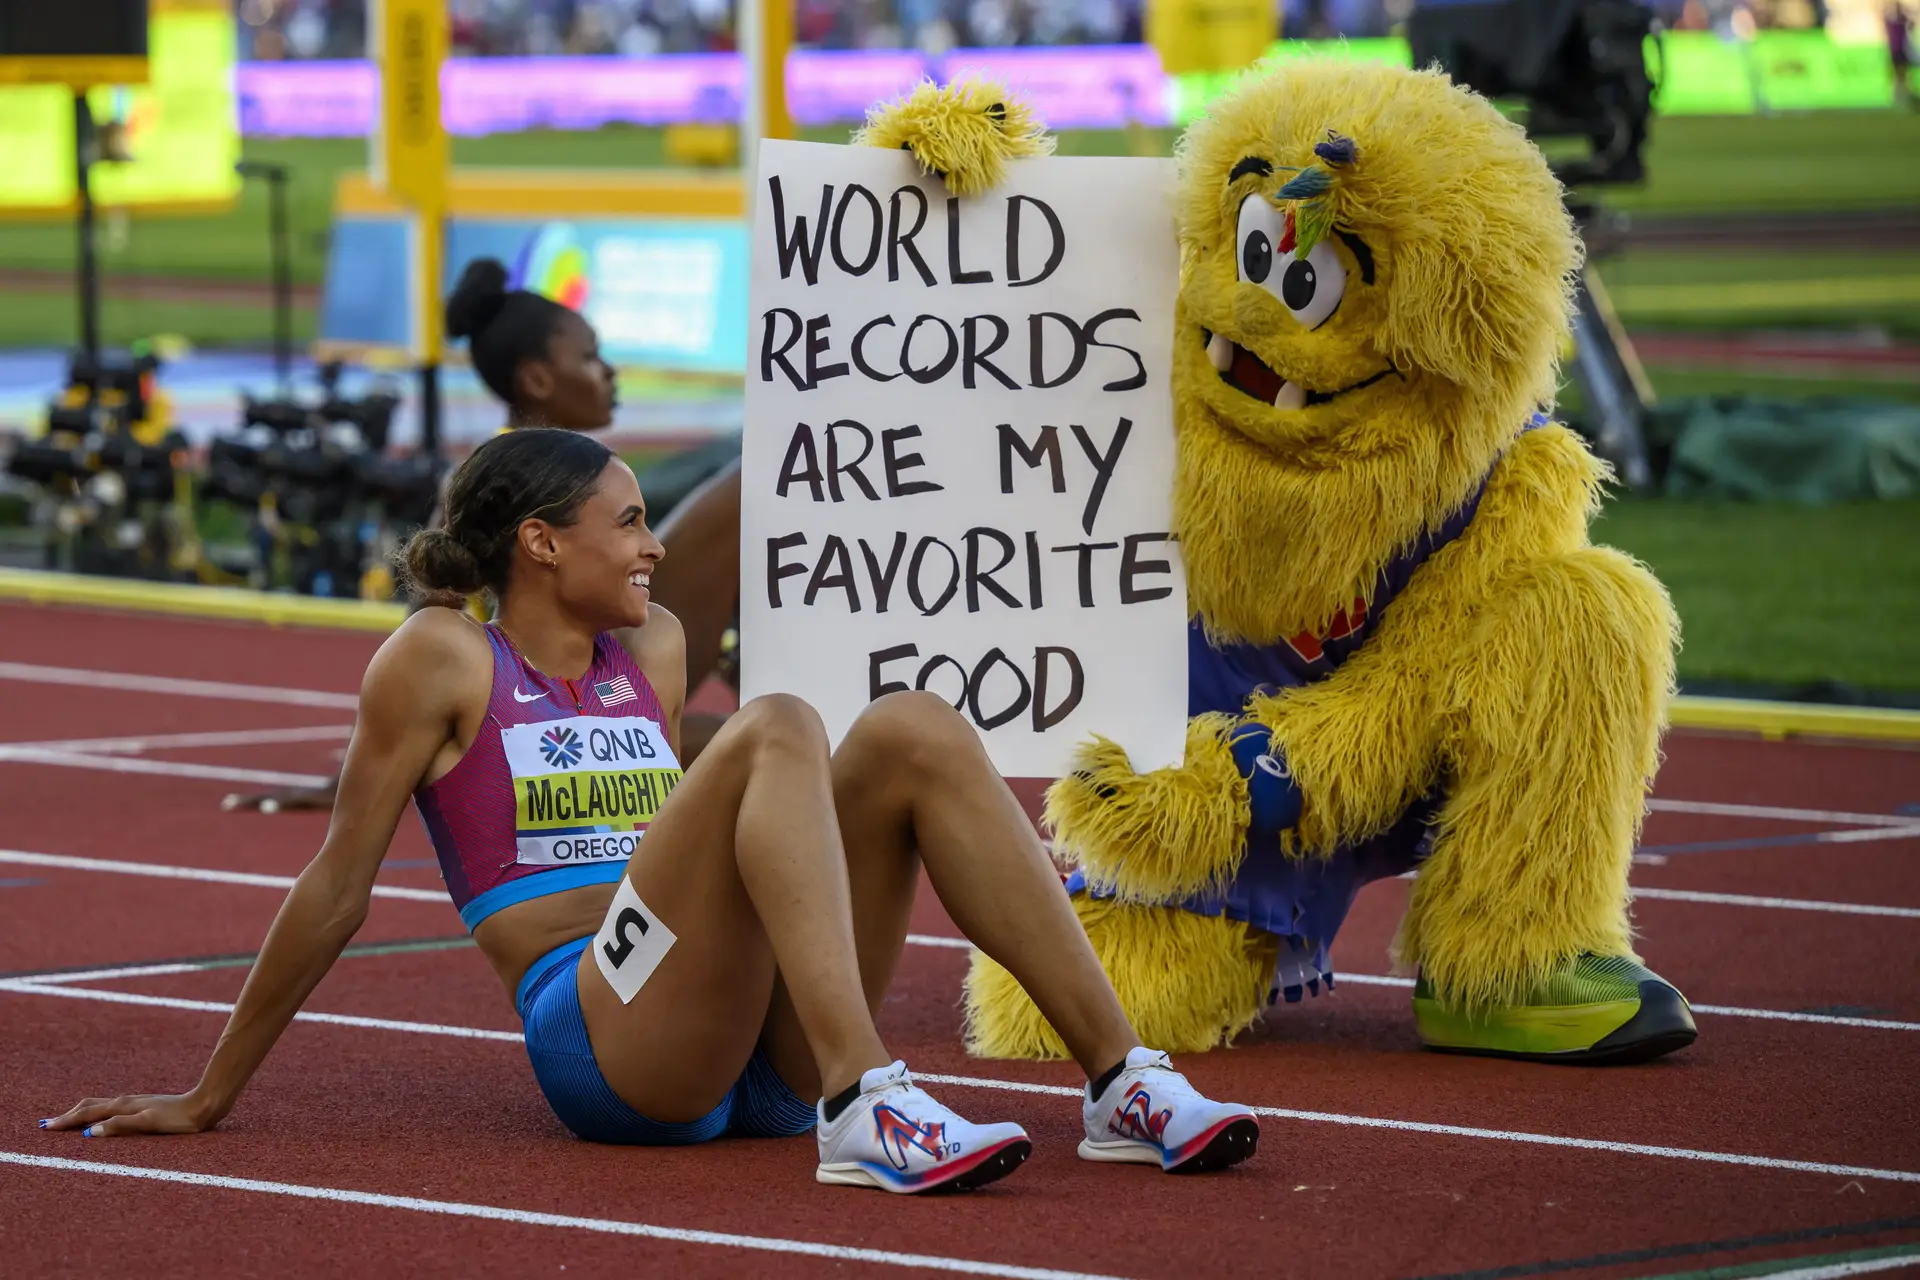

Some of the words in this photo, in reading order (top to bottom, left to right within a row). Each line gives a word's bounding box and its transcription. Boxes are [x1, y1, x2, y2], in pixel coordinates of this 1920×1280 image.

[768, 174, 1066, 288] WORLD
[760, 307, 1148, 392] RECORDS
[776, 419, 945, 503] ARE
[995, 416, 1133, 537] MY
[766, 526, 1180, 617] FAVORITE
[869, 642, 1085, 733] FOOD
[589, 727, 657, 762] QNB
[552, 835, 641, 860] OREGO
[602, 906, 650, 971] 5
